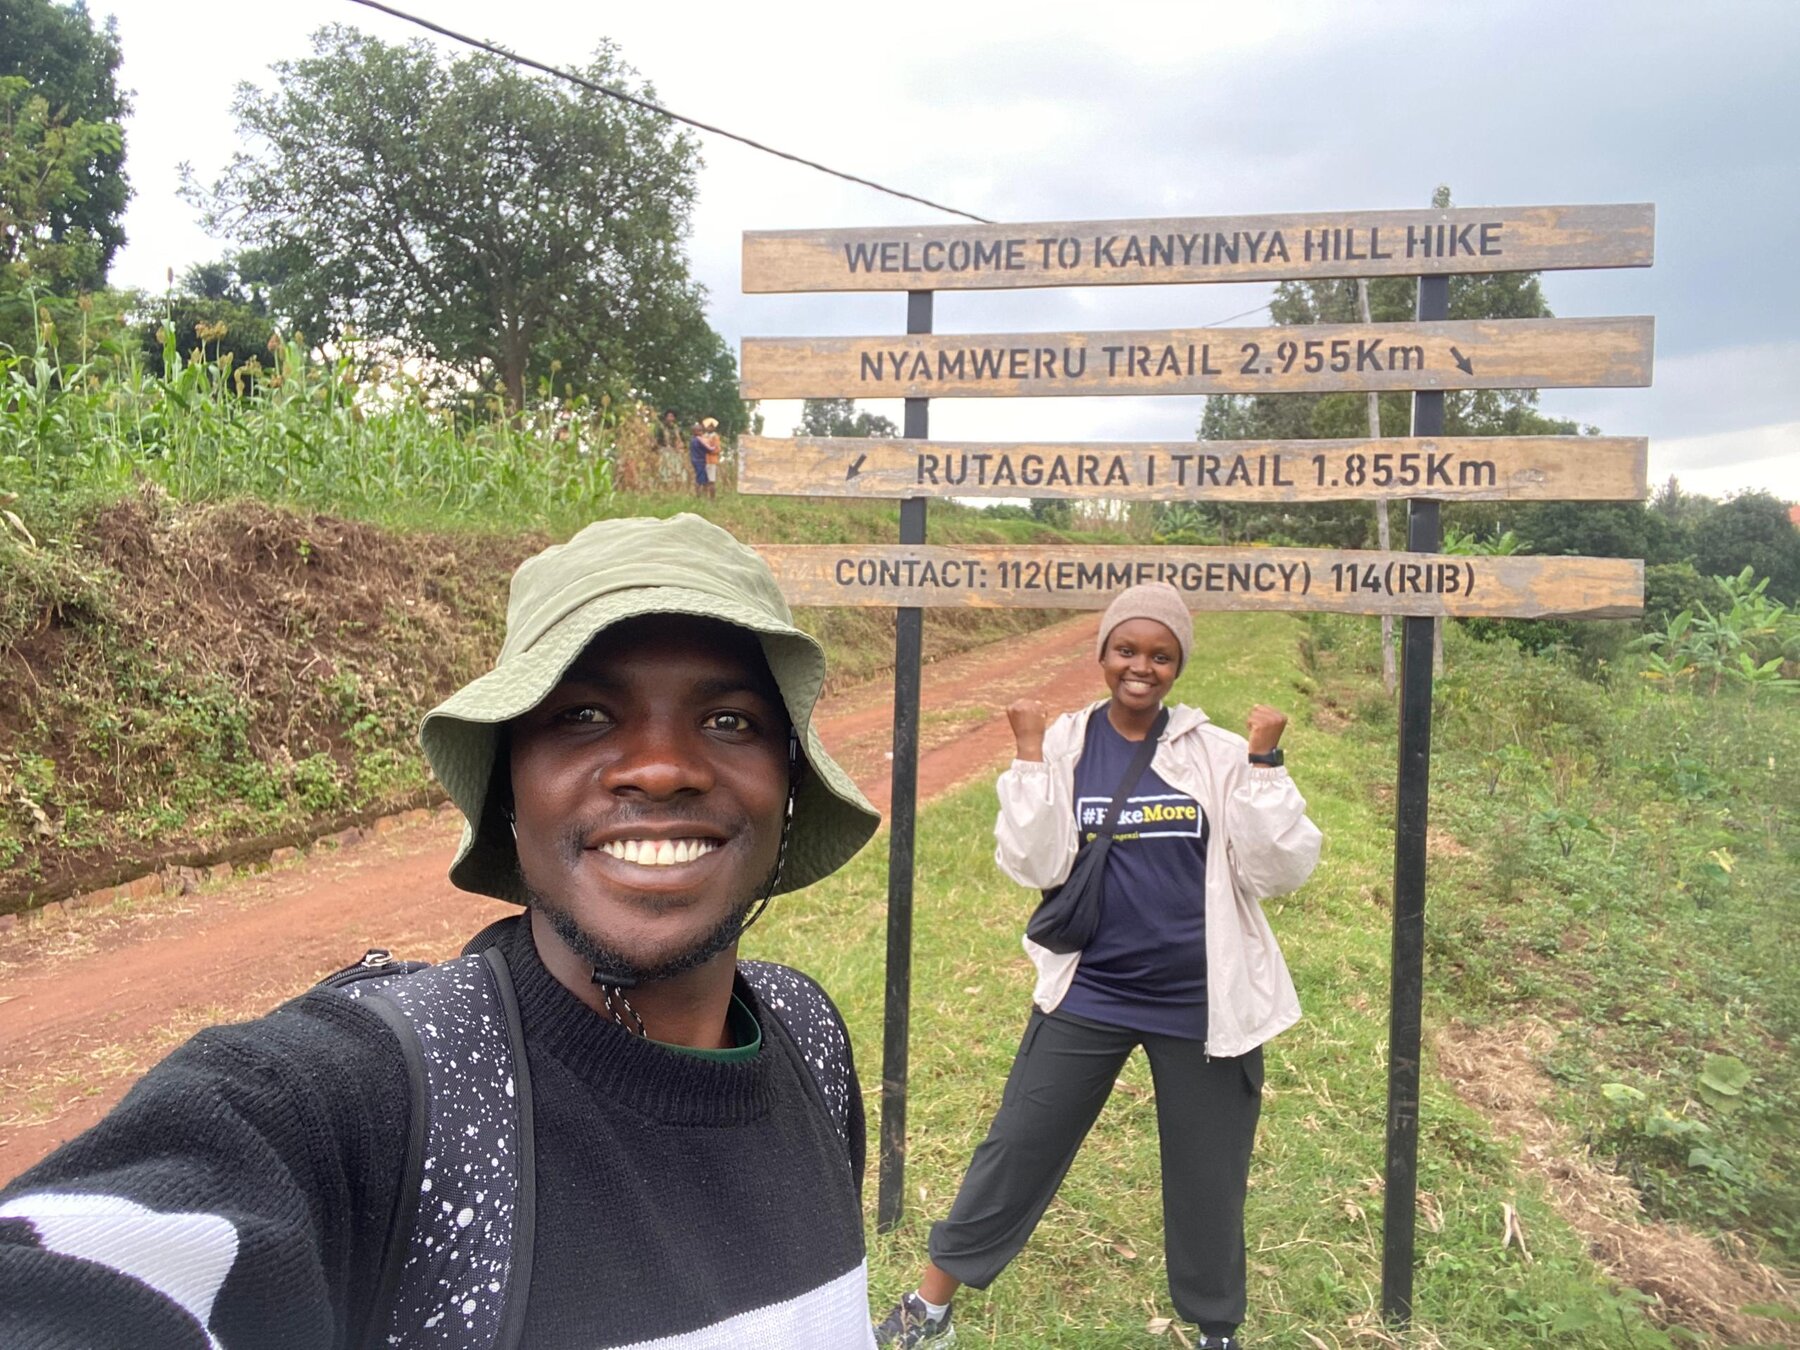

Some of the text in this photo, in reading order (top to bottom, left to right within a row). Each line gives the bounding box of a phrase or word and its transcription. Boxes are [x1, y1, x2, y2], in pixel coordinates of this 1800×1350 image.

[844, 222, 1504, 274] WELCOME TO KANYINYA HILL HIKE
[860, 338, 1424, 382] NYAMWERU TRAIL 2.955Km
[917, 453, 1496, 487] RUTAGARA I TRAIL 1.855Km
[835, 559, 988, 589] CONTACT:
[1330, 561, 1475, 597] 114(RIB)
